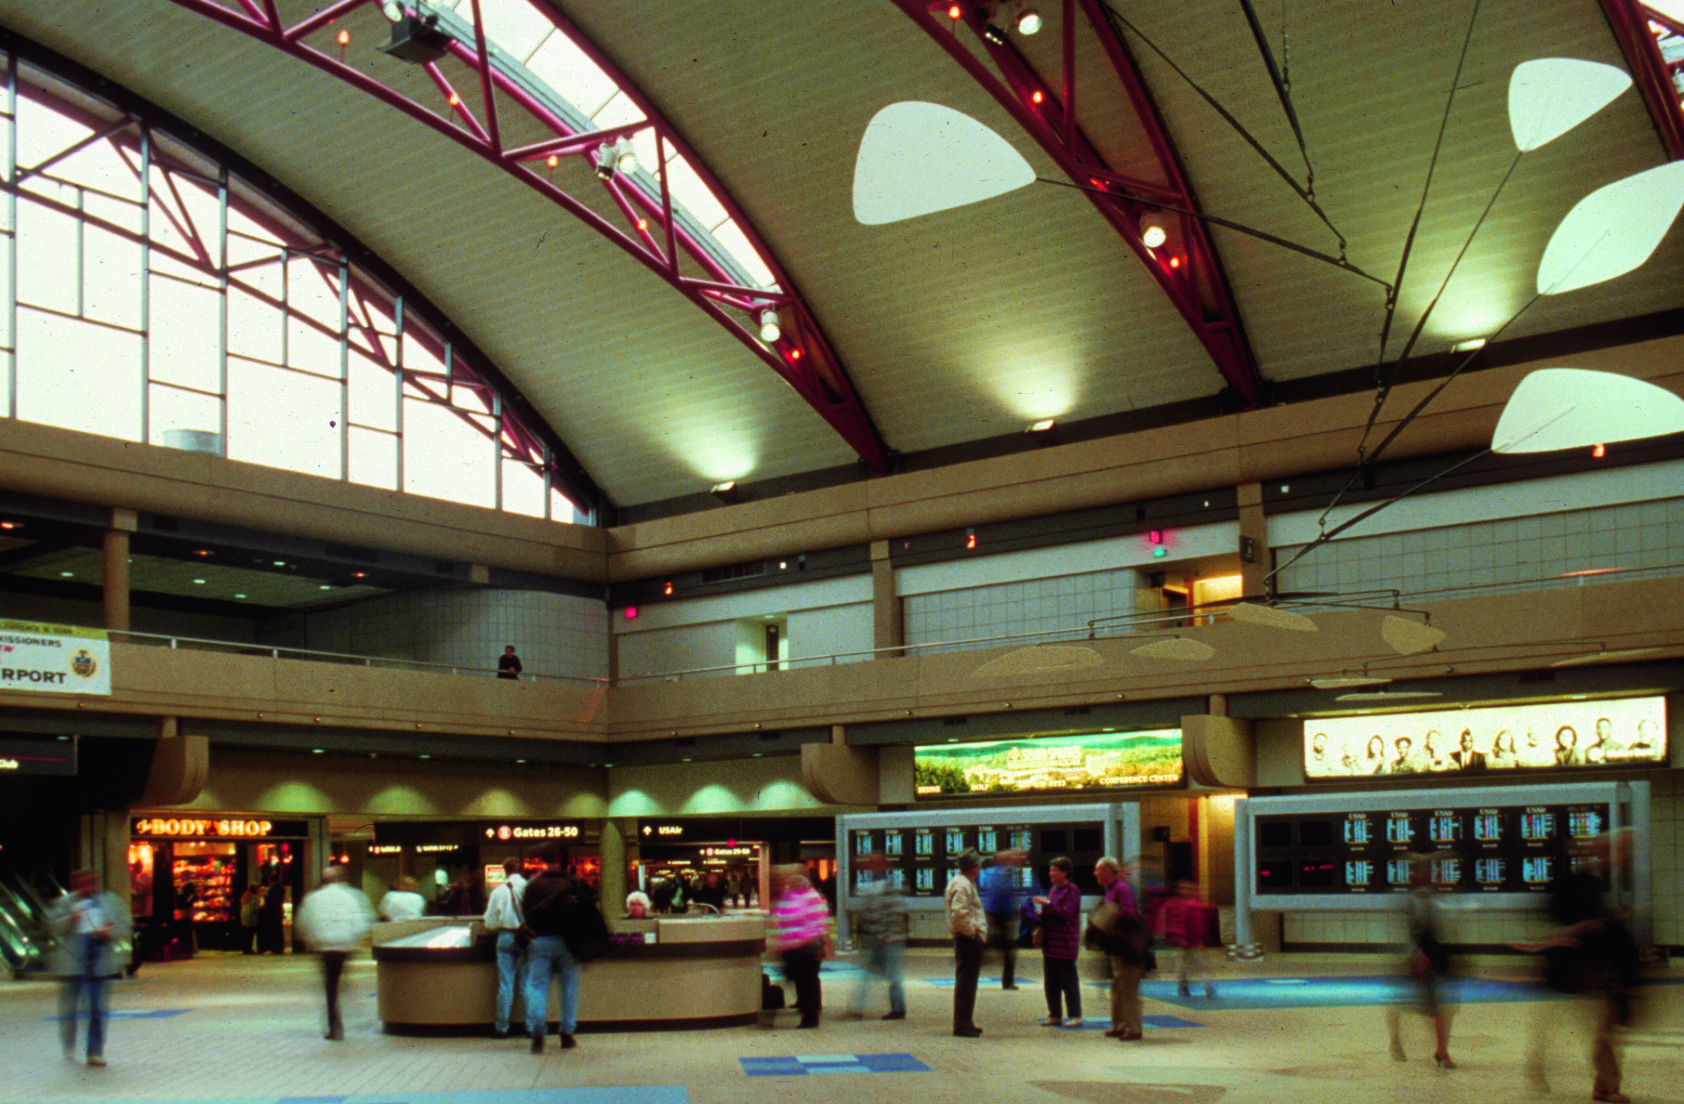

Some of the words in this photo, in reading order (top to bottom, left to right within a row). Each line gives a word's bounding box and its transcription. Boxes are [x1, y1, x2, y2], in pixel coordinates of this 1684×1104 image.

[150, 818, 207, 835] BODY
[217, 819, 272, 836] SHOP
[513, 826, 546, 838] Gates
[547, 826, 578, 838] 26-50
[658, 826, 683, 835] USAir
